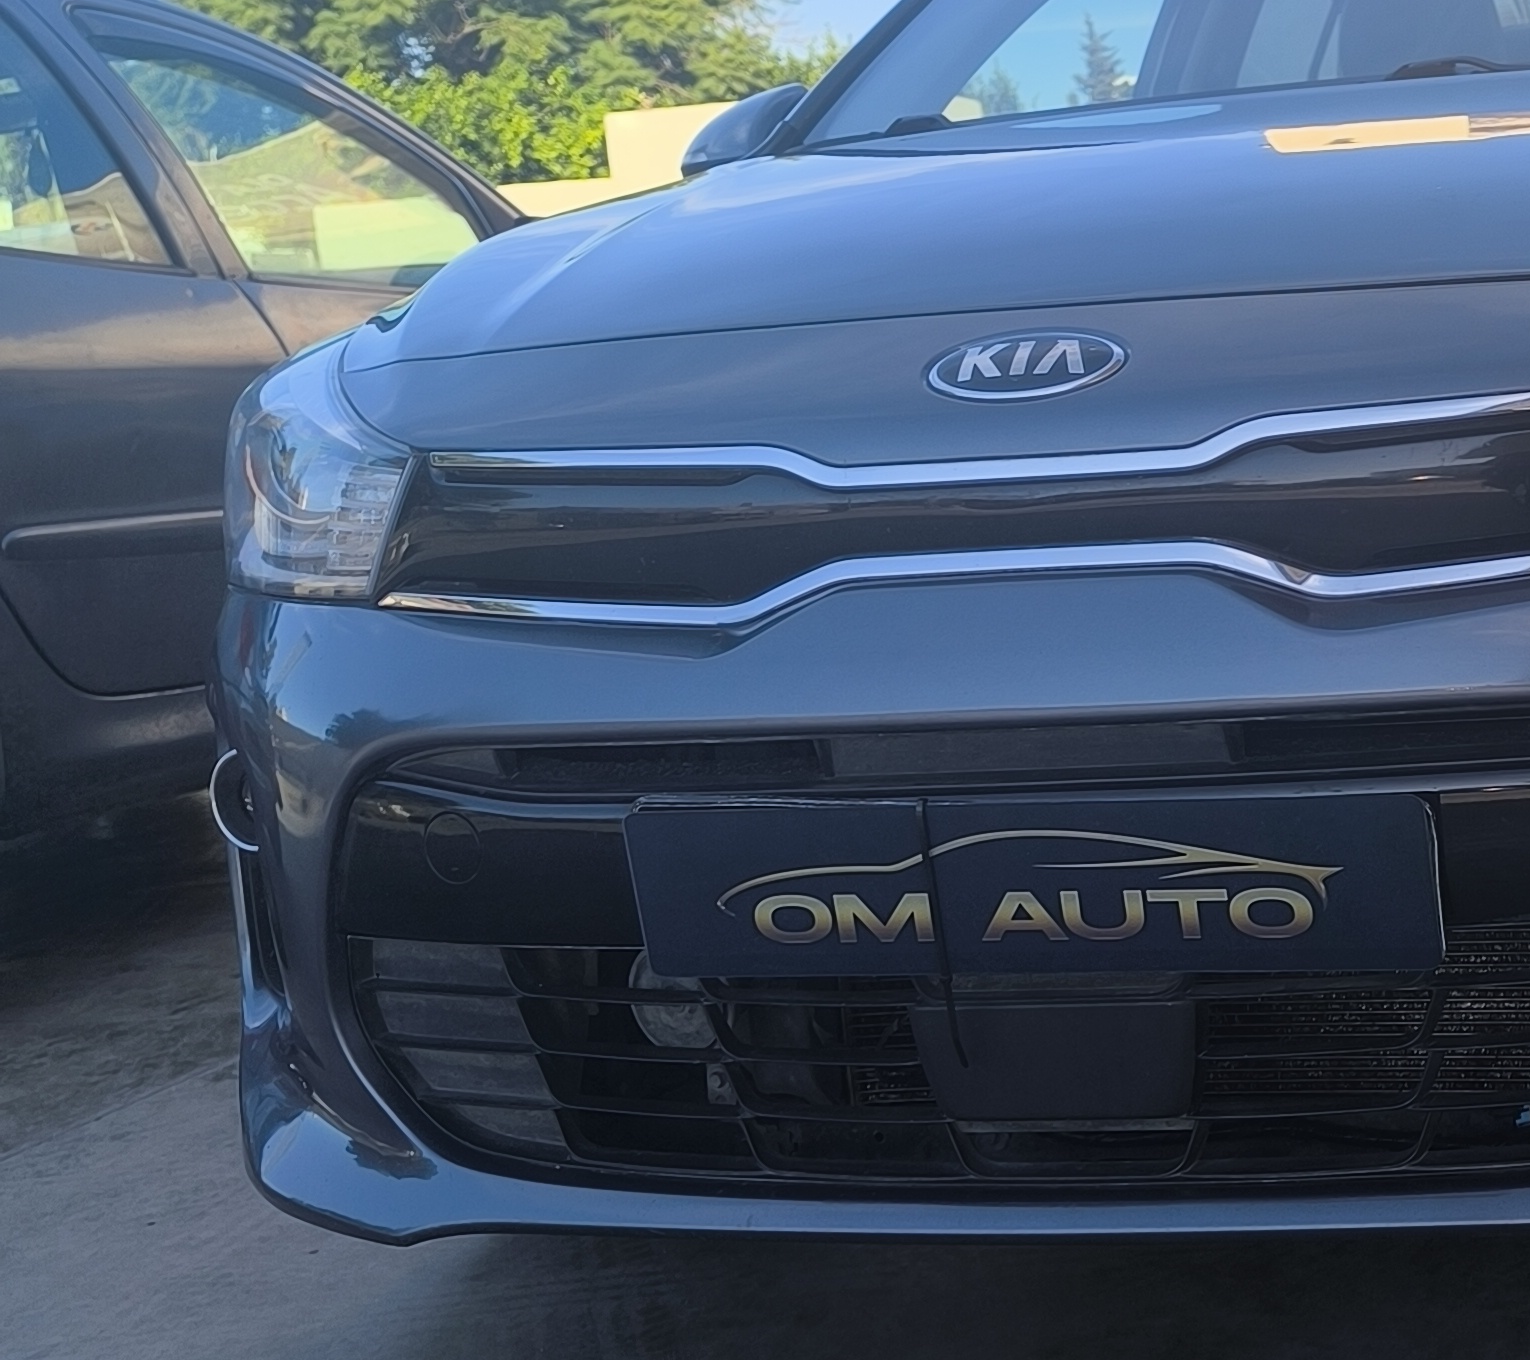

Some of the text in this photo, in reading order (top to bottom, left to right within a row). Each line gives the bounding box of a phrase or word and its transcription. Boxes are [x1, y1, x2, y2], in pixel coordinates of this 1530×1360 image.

[957, 339, 1085, 382] KIA
[753, 888, 1315, 944] OM AUTO
